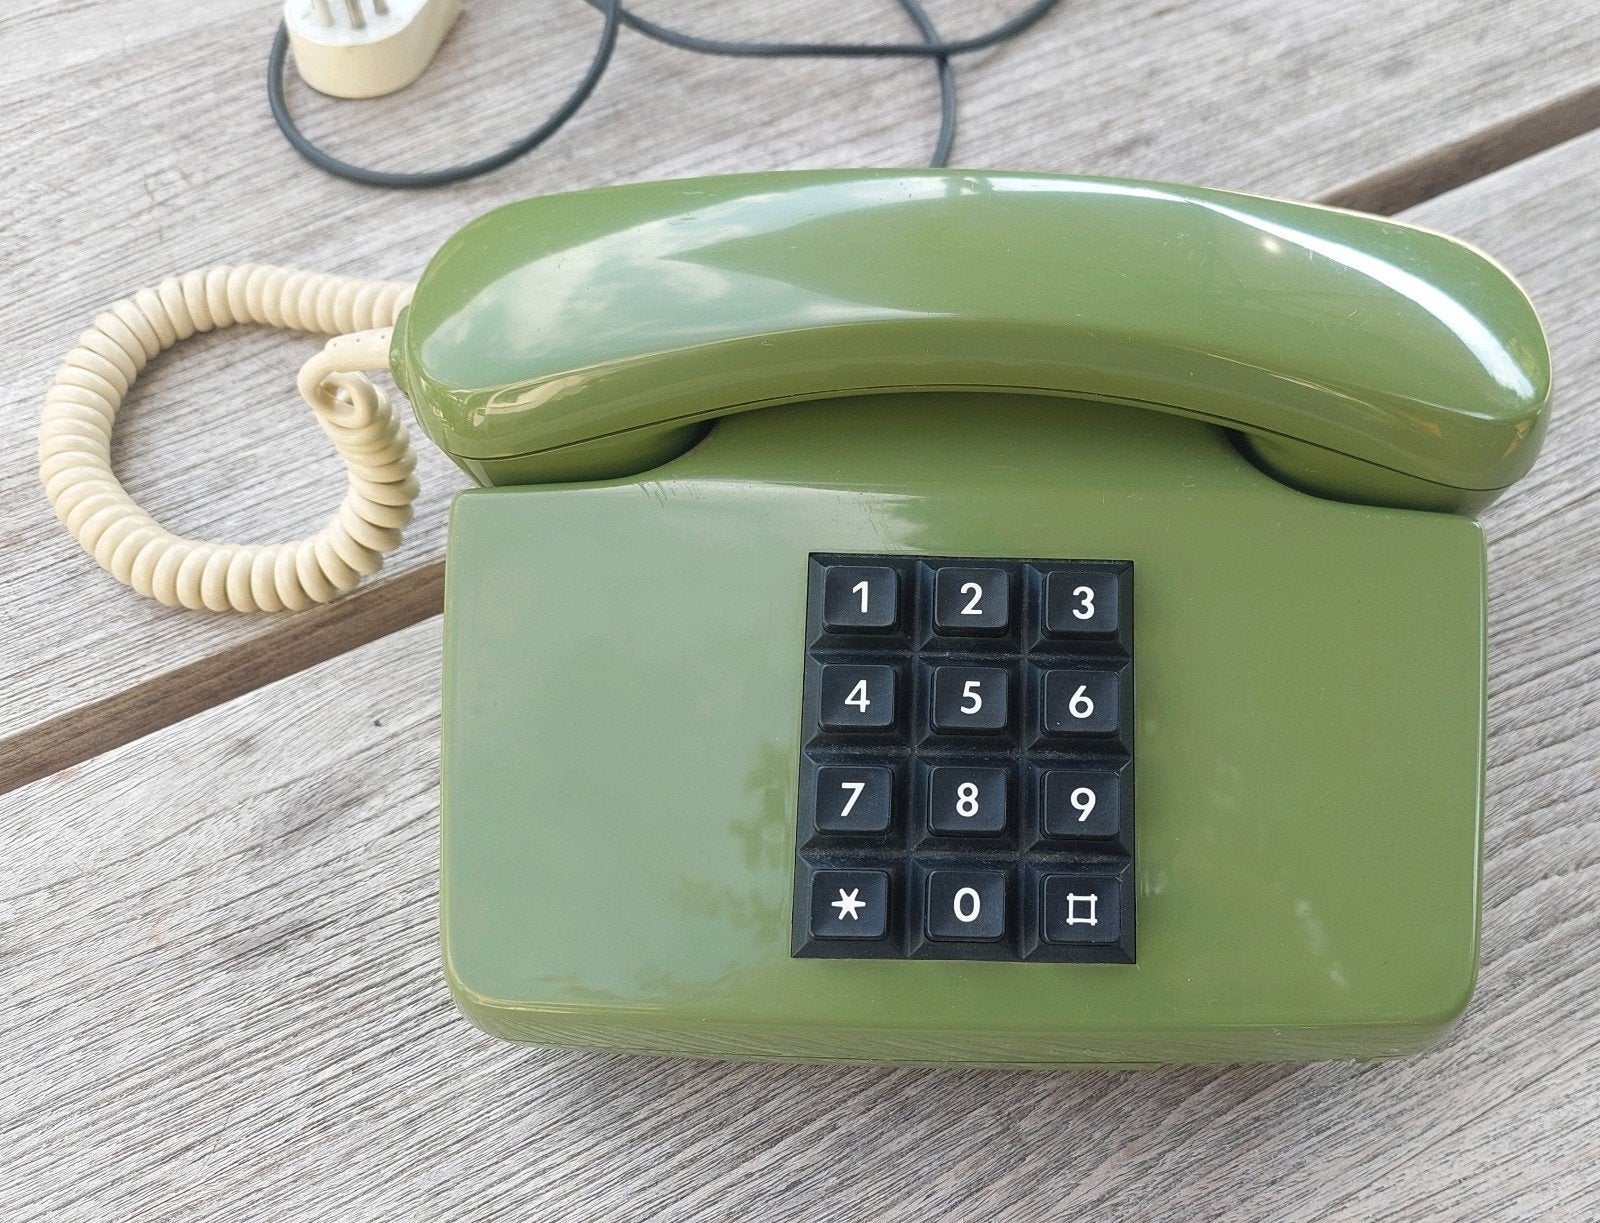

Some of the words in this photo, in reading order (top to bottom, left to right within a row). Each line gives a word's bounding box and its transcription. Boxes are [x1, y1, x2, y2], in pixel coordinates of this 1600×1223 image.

[852, 580, 869, 614] 1
[960, 581, 983, 615] 2
[1072, 585, 1095, 620] 3
[844, 679, 871, 713] 4
[960, 680, 983, 715] 5
[1068, 684, 1095, 719] 6
[840, 782, 866, 817] 7
[955, 781, 979, 818] 8
[1070, 787, 1097, 822] 9
[953, 886, 981, 923] 0
